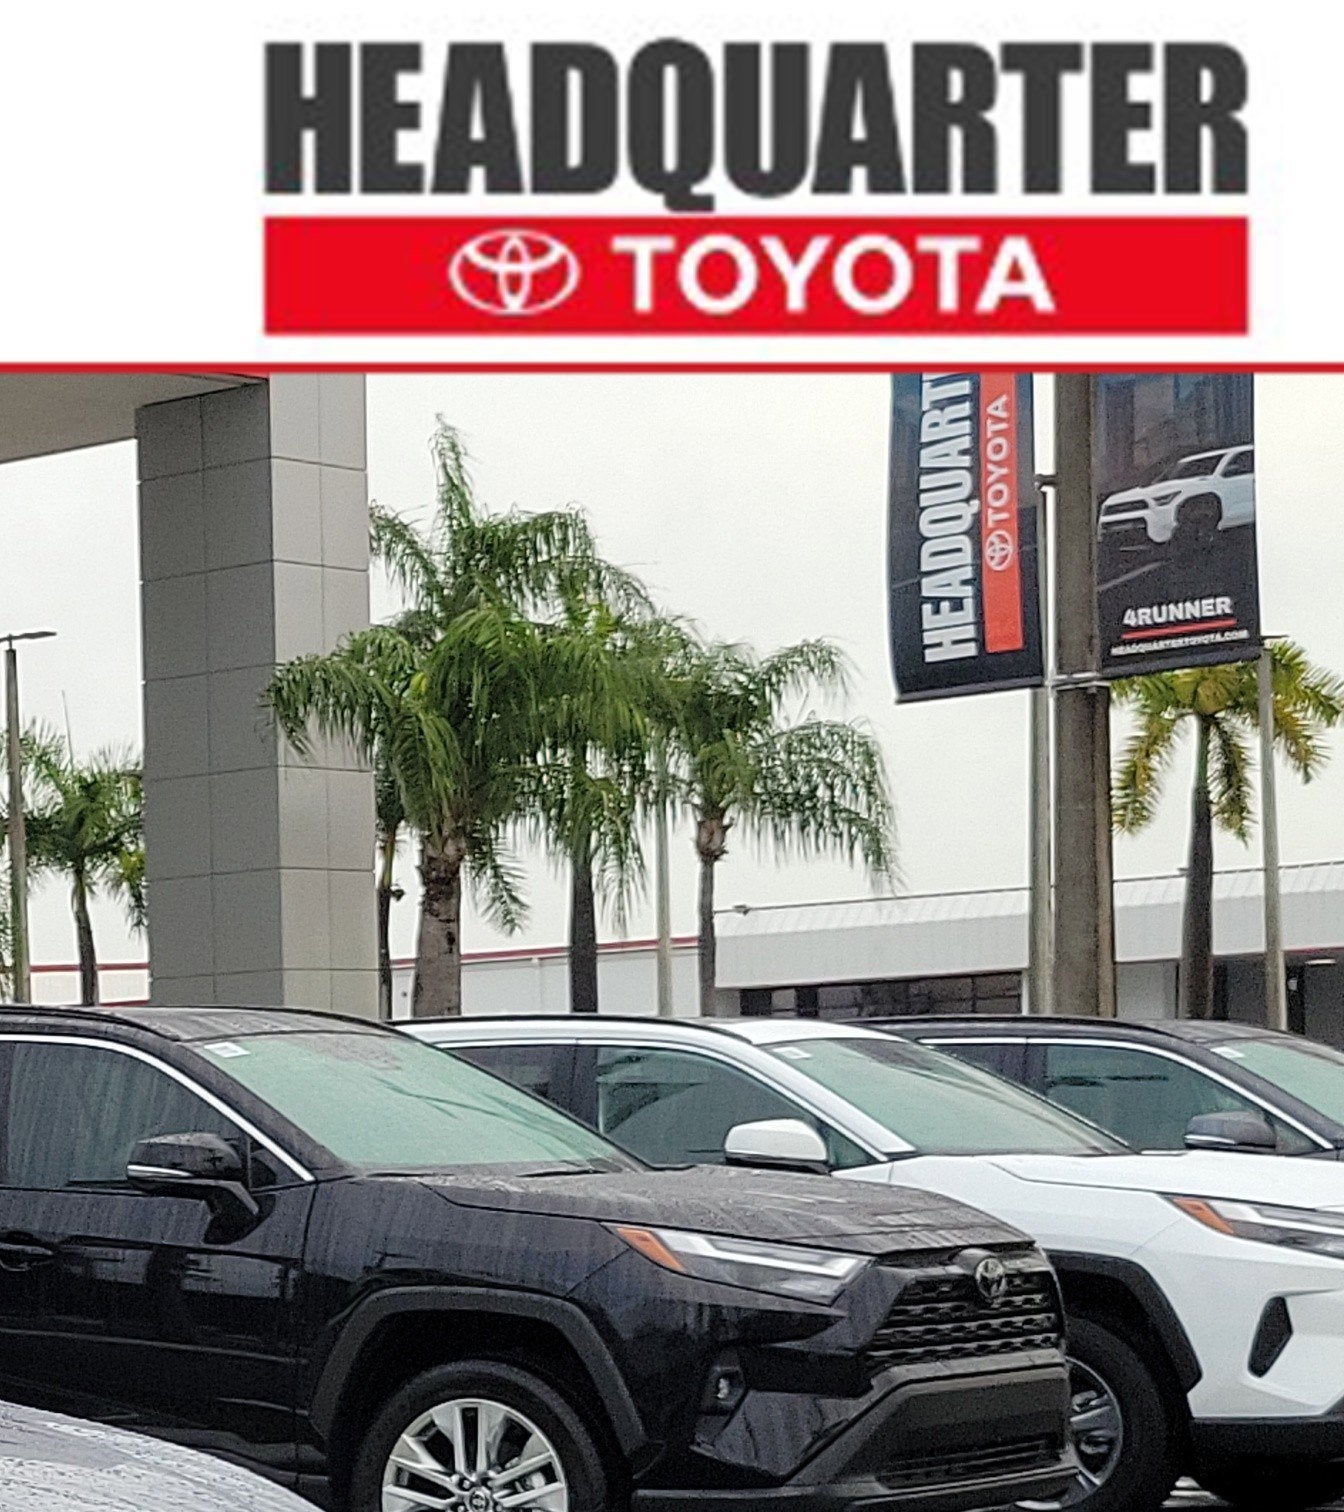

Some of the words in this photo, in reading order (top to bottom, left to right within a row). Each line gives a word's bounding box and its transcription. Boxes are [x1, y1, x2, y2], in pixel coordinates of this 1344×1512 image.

[919, 373, 980, 662] HEADQUART
[986, 394, 1011, 526] TOYOTA
[1122, 596, 1233, 627] 4RUNNER
